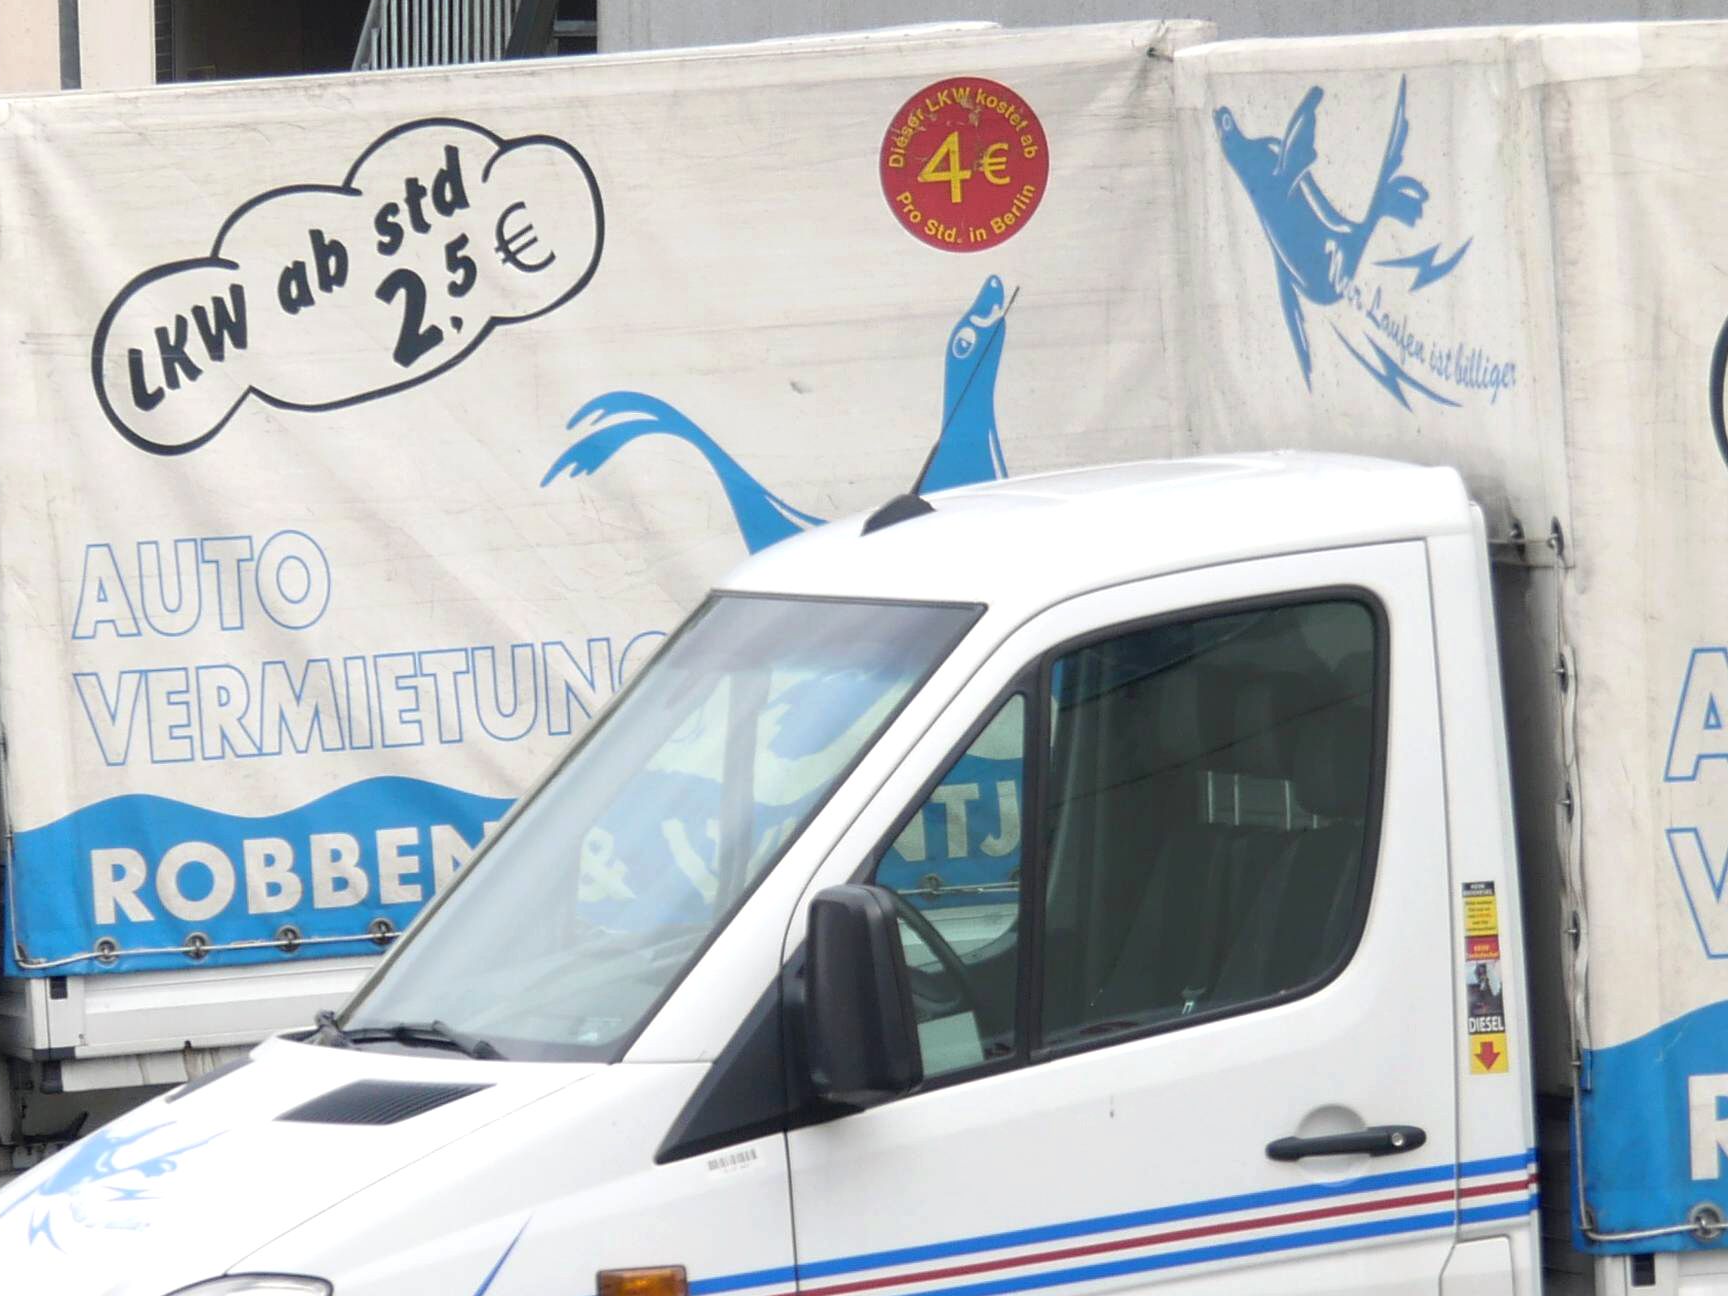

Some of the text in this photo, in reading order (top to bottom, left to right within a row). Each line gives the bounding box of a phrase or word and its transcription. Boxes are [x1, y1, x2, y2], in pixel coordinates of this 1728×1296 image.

[888, 87, 1039, 168] Dieser LKW kostet ab
[896, 184, 1036, 244] Pro Std. in Berlin
[127, 144, 470, 412] LKW ab std
[72, 529, 331, 641] AUTO
[1468, 1015, 1505, 1034] DIESEL
